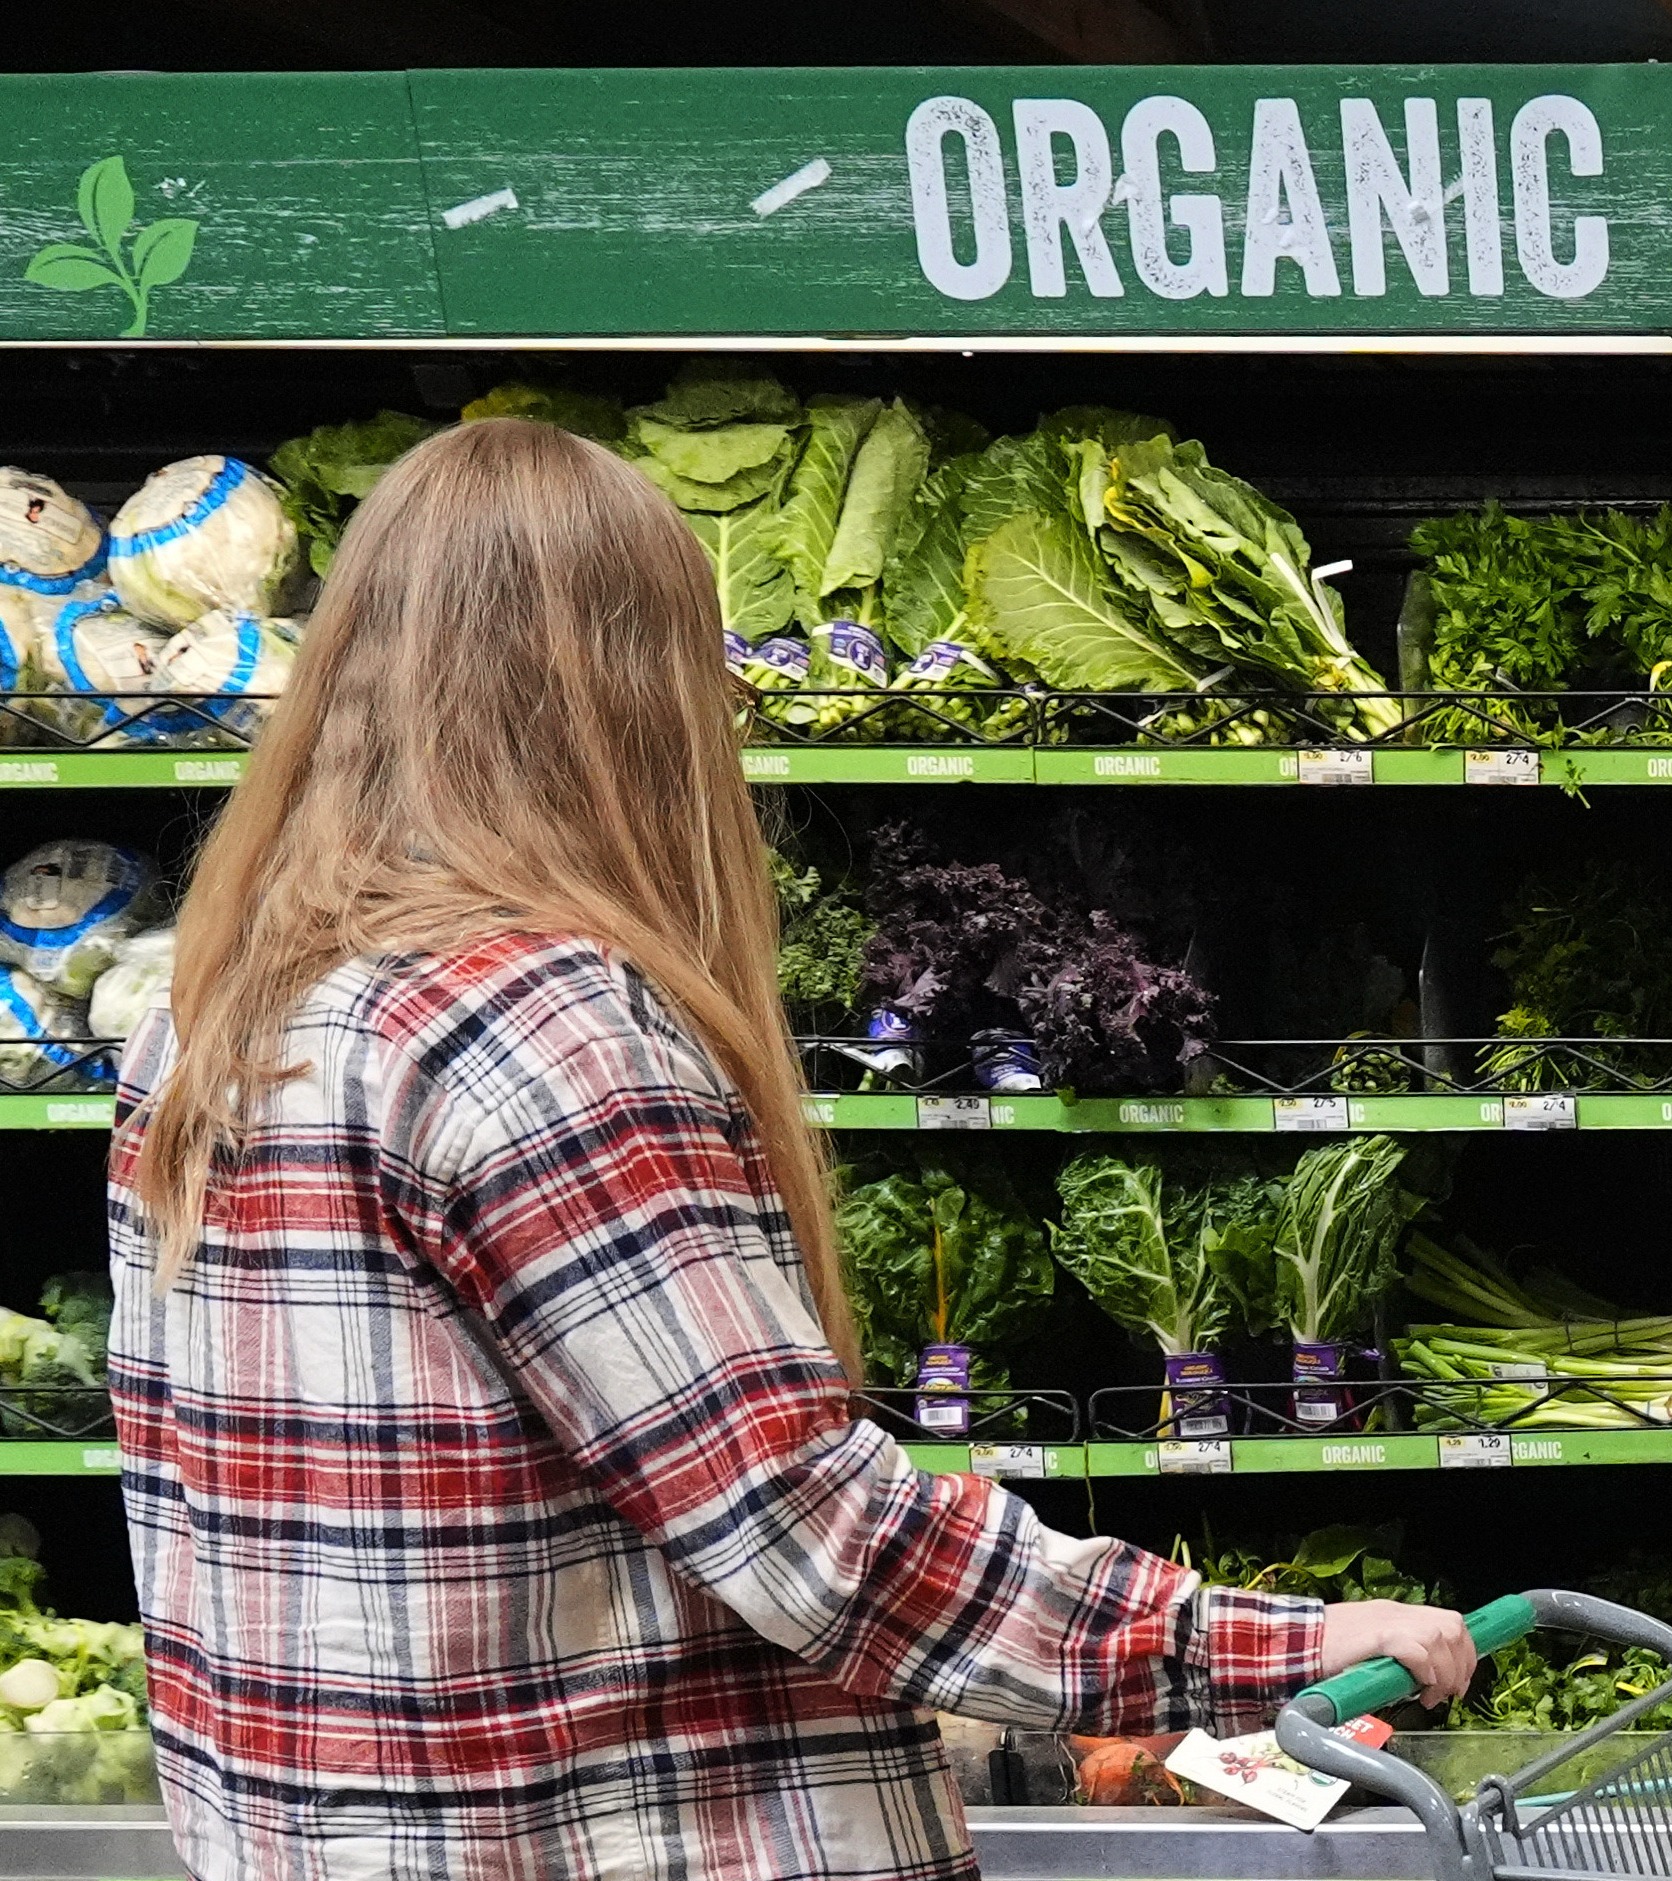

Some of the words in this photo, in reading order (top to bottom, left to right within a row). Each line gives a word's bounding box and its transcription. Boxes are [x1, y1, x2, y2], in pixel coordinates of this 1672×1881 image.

[905, 94, 1610, 300] ORGANIC
[742, 756, 790, 774] GANIC
[907, 756, 973, 775] ORGANIC
[1094, 756, 1160, 776] ORGANIC
[1119, 1105, 1184, 1123] ORGANIC
[1322, 1445, 1385, 1463] ORGANIC
[1512, 1441, 1562, 1459] RGANIC
